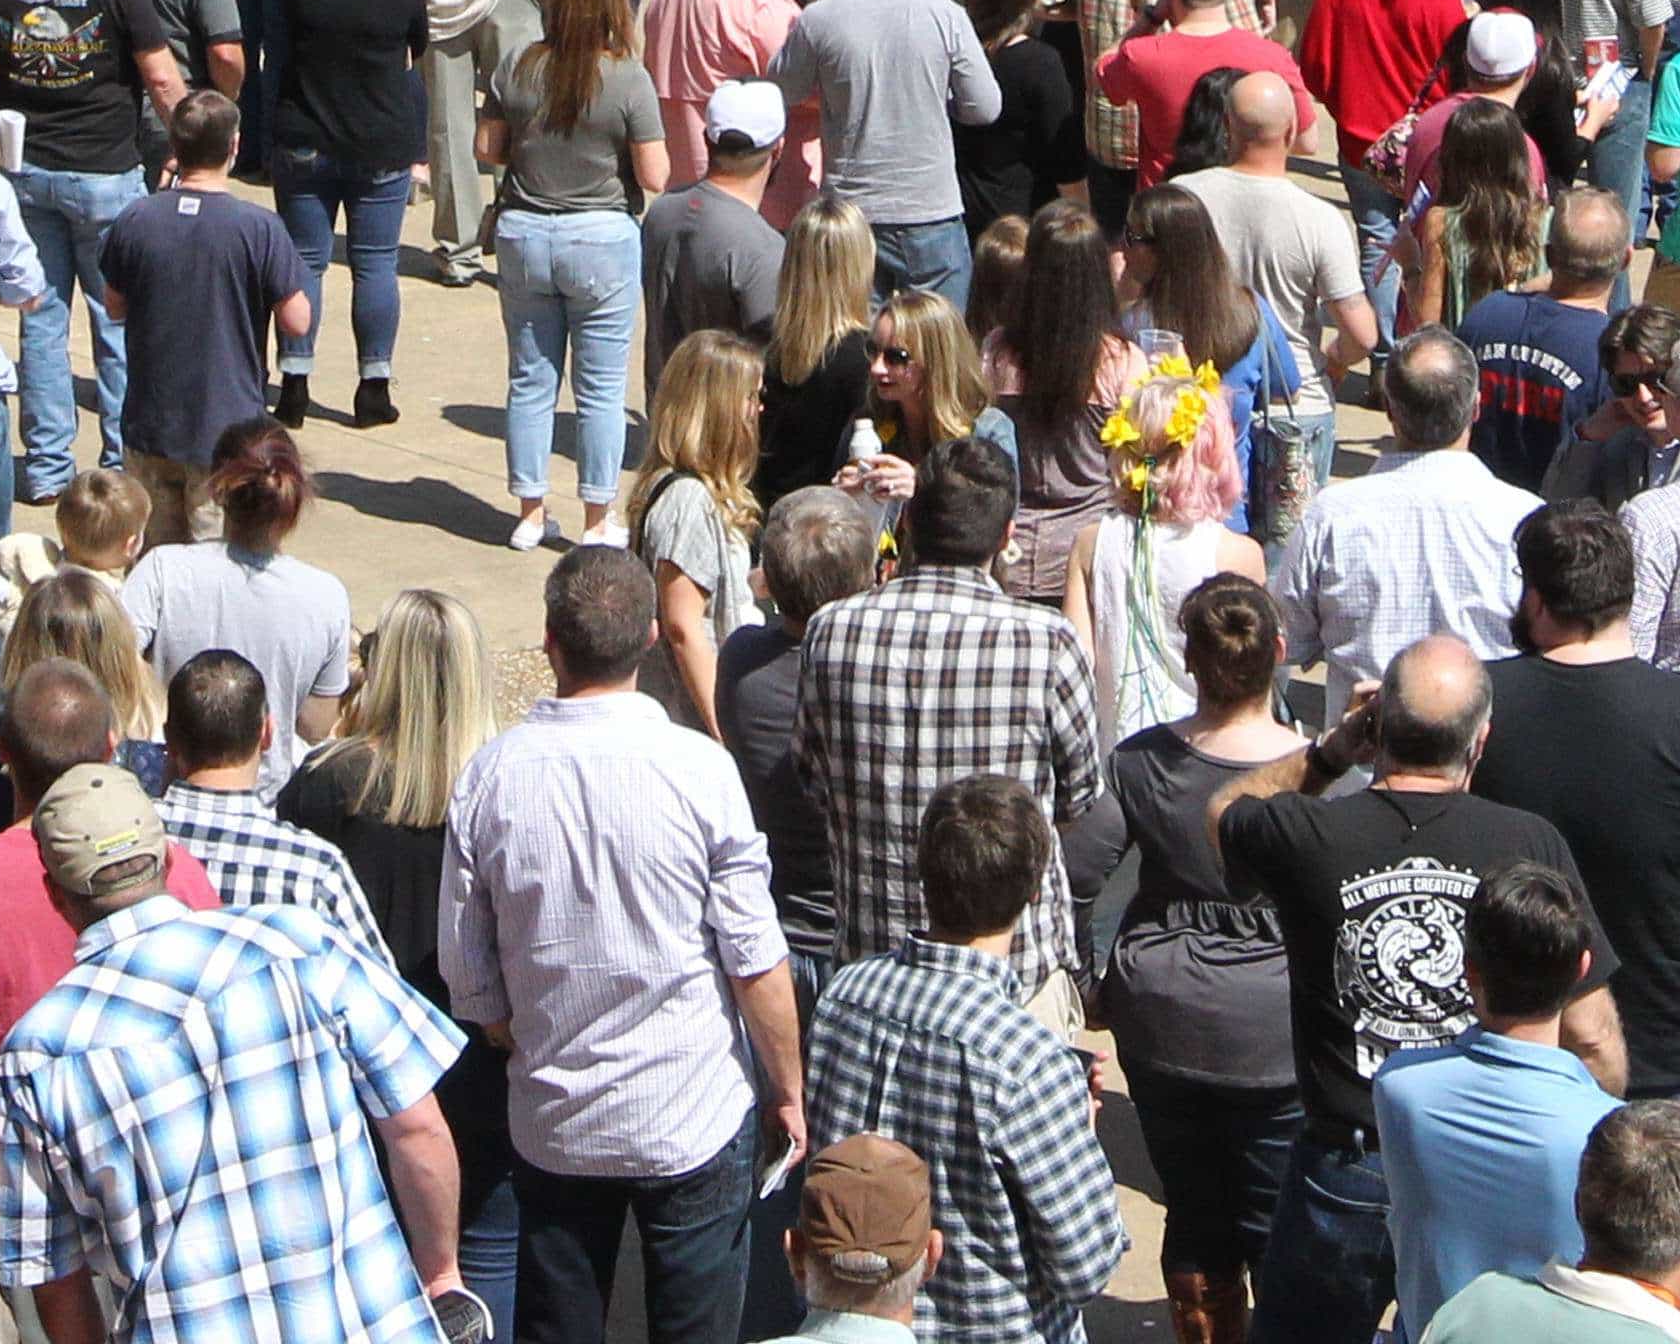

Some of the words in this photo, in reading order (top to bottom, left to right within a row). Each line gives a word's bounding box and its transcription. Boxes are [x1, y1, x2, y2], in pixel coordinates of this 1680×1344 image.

[1341, 893, 1365, 910] ALL
[1363, 881, 1390, 901] MEN
[1389, 876, 1412, 894] ARE
[1413, 877, 1461, 894] CREATED
[1376, 1018, 1393, 1035] BUT
